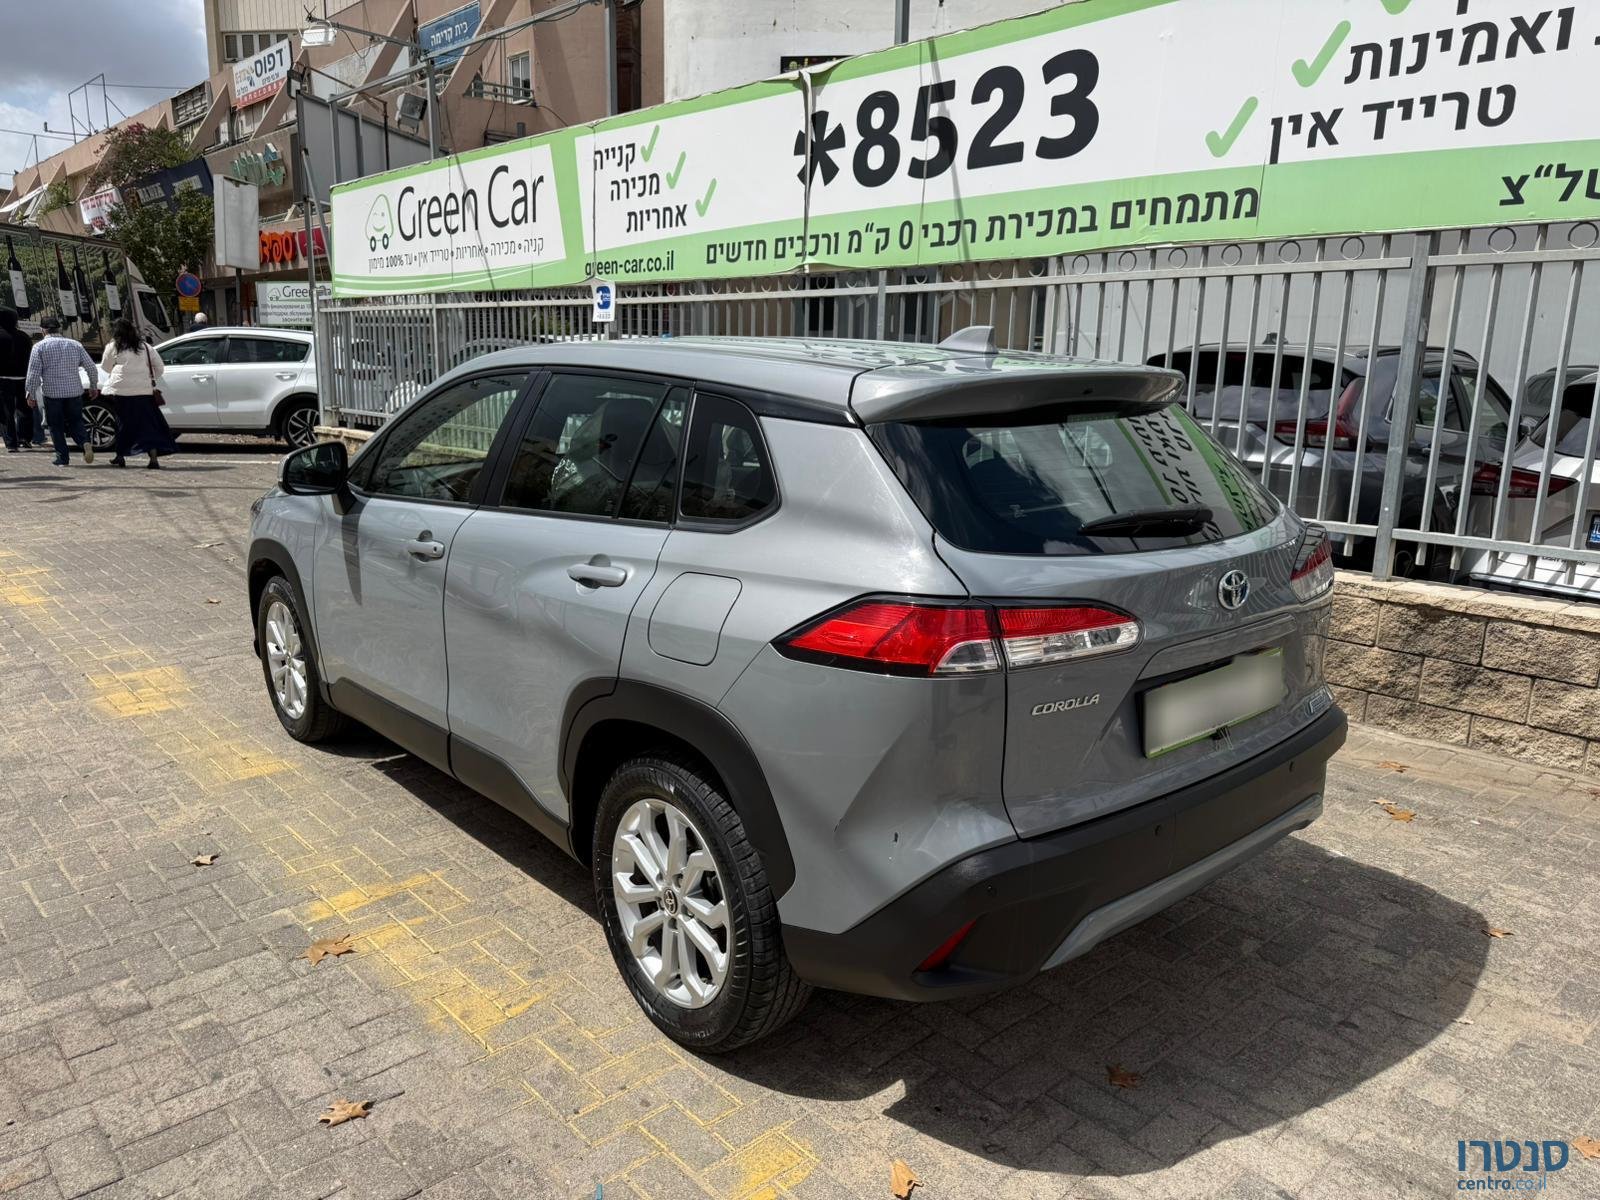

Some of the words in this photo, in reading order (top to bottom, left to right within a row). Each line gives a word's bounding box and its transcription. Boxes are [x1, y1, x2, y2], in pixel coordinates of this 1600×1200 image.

[1343, 7, 1576, 85] ואמינות
[254, 48, 283, 78] דפוס
[1362, 83, 1517, 141] טרייד
[1269, 108, 1345, 166] אין
[594, 142, 637, 173] קנייה
[610, 172, 661, 202] מכירה
[397, 186, 479, 242] Green
[487, 164, 544, 229] Car
[1110, 187, 1259, 231] מתמחים
[626, 204, 688, 234] אחריות
[921, 217, 977, 249] רכבי
[985, 205, 1098, 243] במכירת
[490, 241, 516, 256] מכירה
[523, 237, 544, 255] קניה
[774, 232, 840, 260] ורכבים
[899, 220, 914, 250] 0
[386, 255, 404, 268] 100%
[417, 251, 428, 267] אין
[429, 248, 450, 262] טרייד
[455, 244, 484, 260] אחריות
[706, 238, 768, 265] חדשים
[1031, 693, 1100, 716] COROLLA
